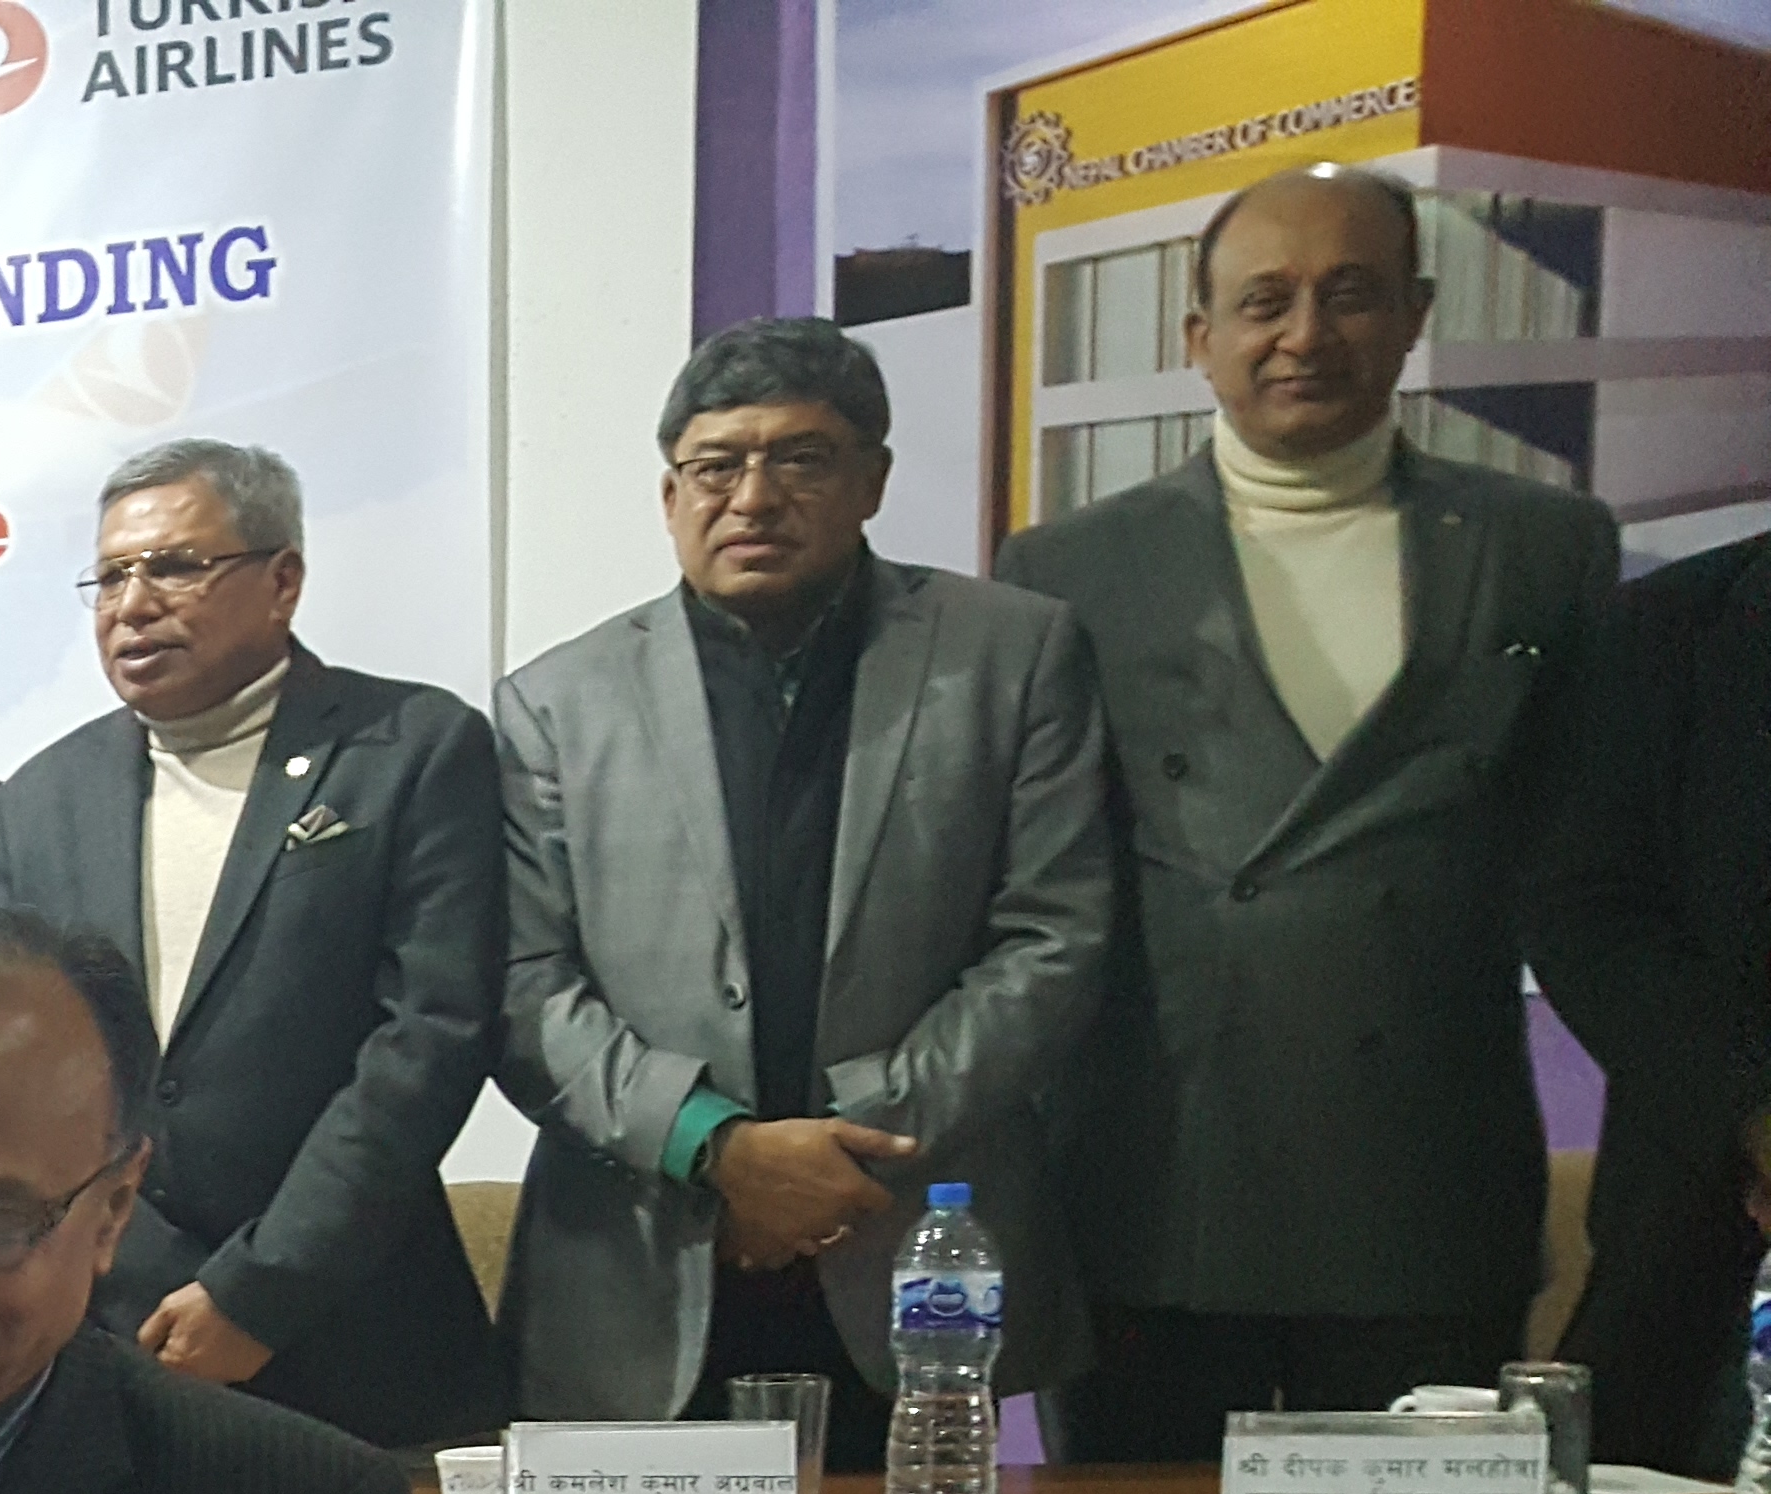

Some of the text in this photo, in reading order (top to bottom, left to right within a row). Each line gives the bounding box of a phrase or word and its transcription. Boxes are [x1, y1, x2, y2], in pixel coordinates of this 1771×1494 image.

[81, 11, 394, 102] AIRLINES
[1235, 112, 1271, 150] OF
[1276, 78, 1418, 138] COMMERCE
